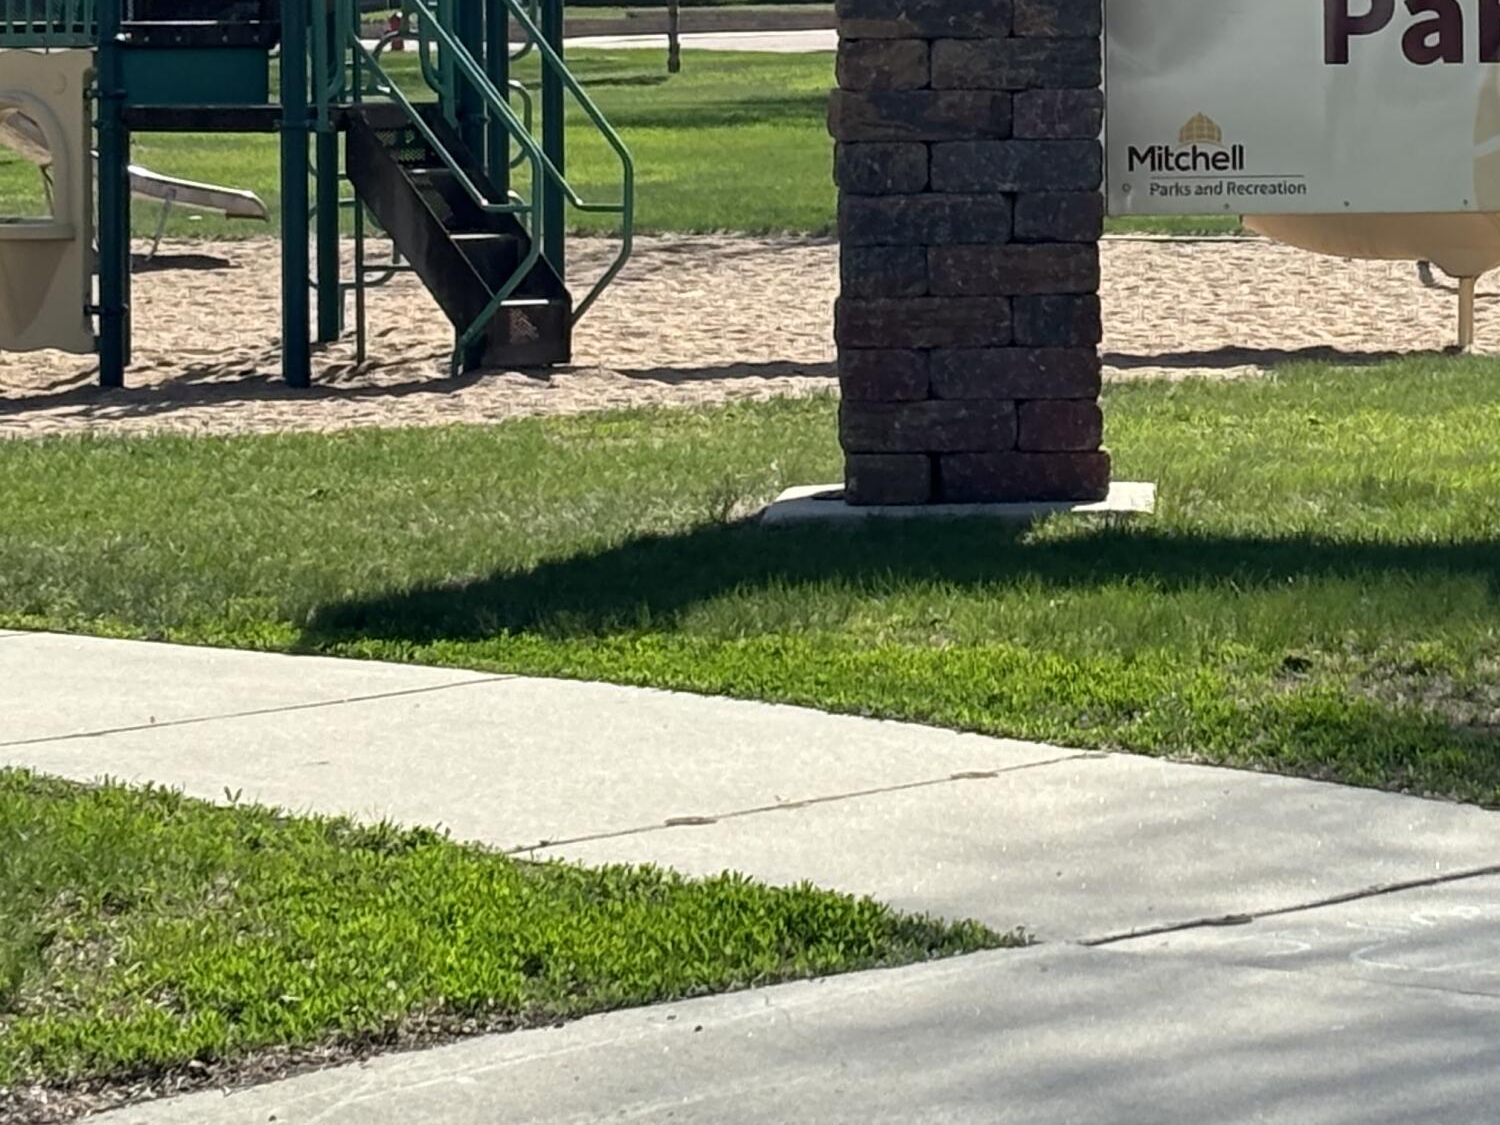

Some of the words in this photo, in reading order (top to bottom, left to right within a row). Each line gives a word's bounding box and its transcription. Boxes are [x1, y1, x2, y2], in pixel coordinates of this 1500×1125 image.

[1128, 144, 1244, 172] Mitchell
[1150, 181, 1192, 197] Parks
[1194, 180, 1223, 196] and
[1227, 180, 1307, 196] Recreation
